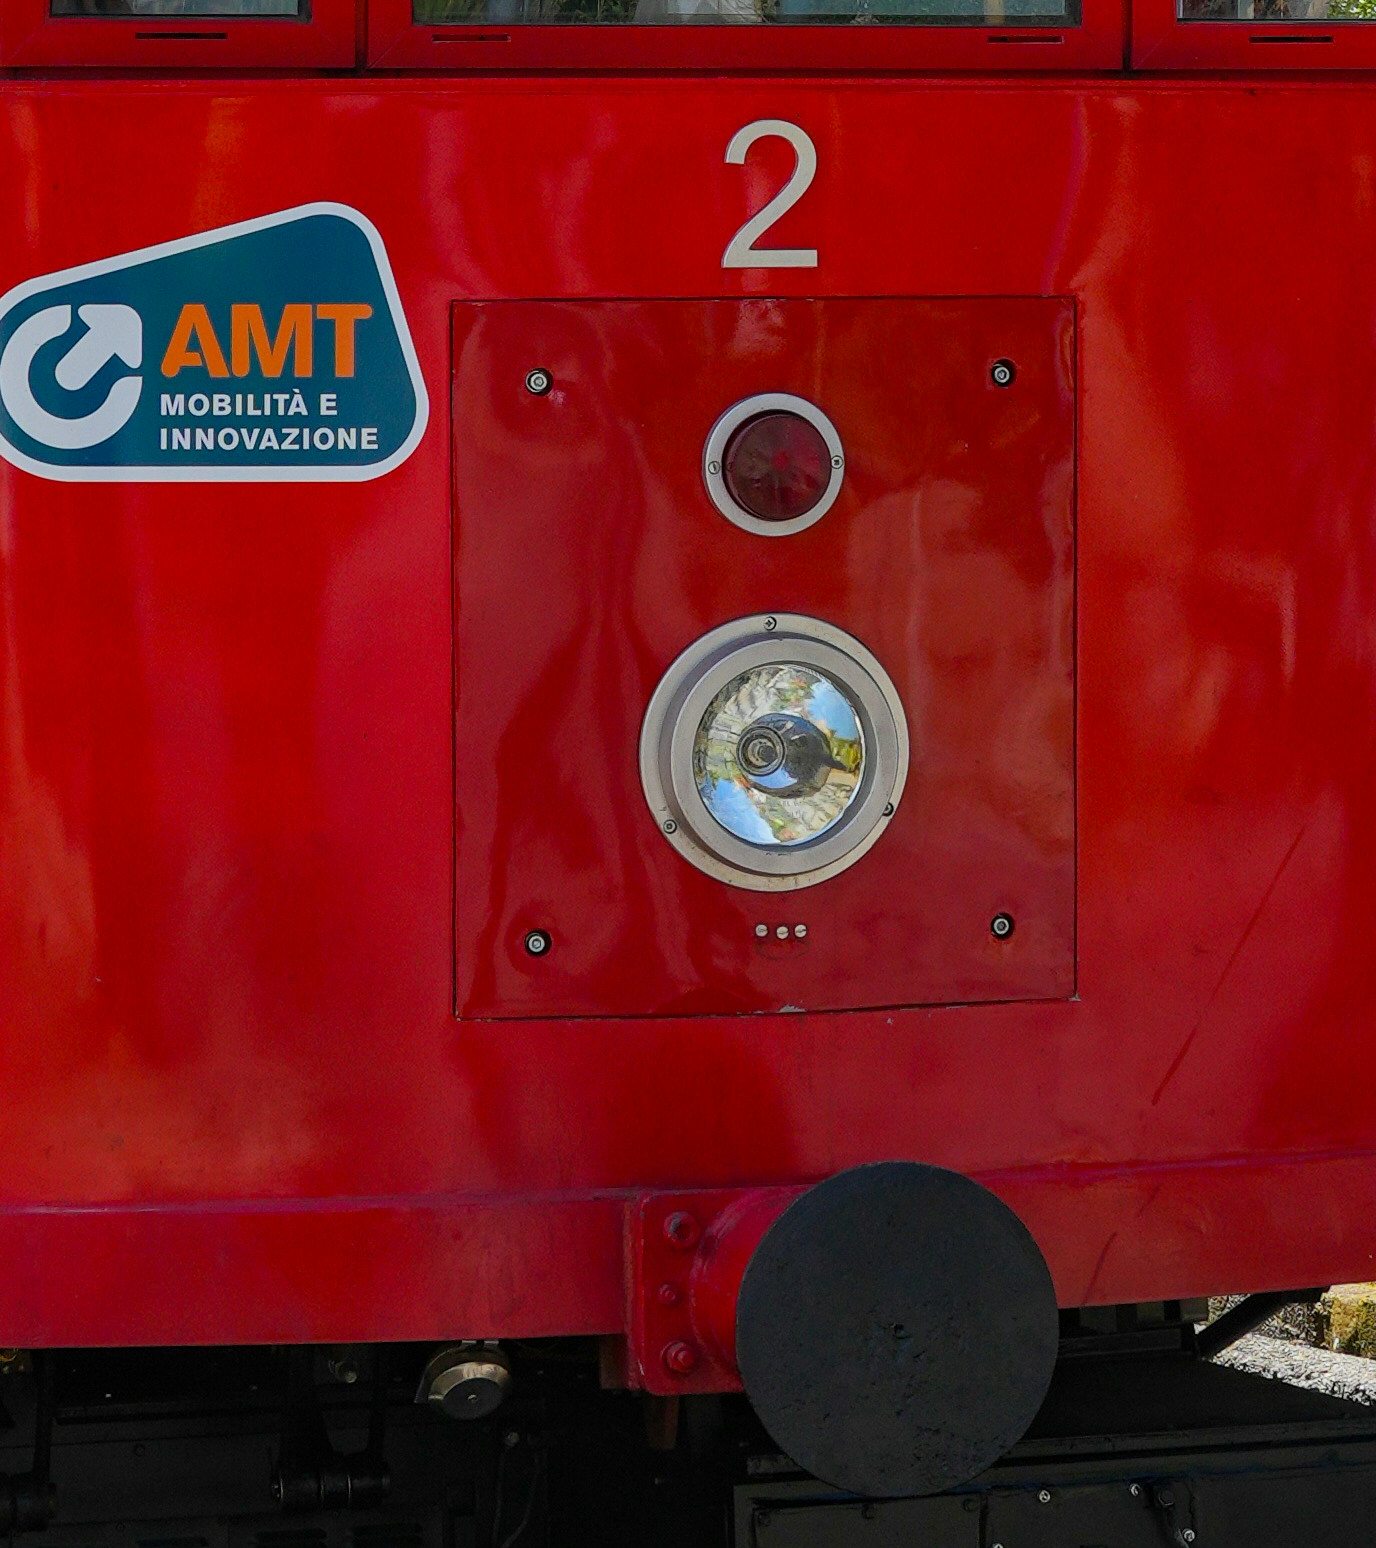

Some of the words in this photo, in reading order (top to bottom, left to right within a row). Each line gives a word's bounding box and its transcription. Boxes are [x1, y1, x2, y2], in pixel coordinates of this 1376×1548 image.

[720, 118, 819, 269] 2
[159, 303, 374, 379] AMT
[159, 387, 308, 417] MOBILITÀ
[319, 393, 338, 417] E
[159, 427, 379, 451] INNOVAZIONE
